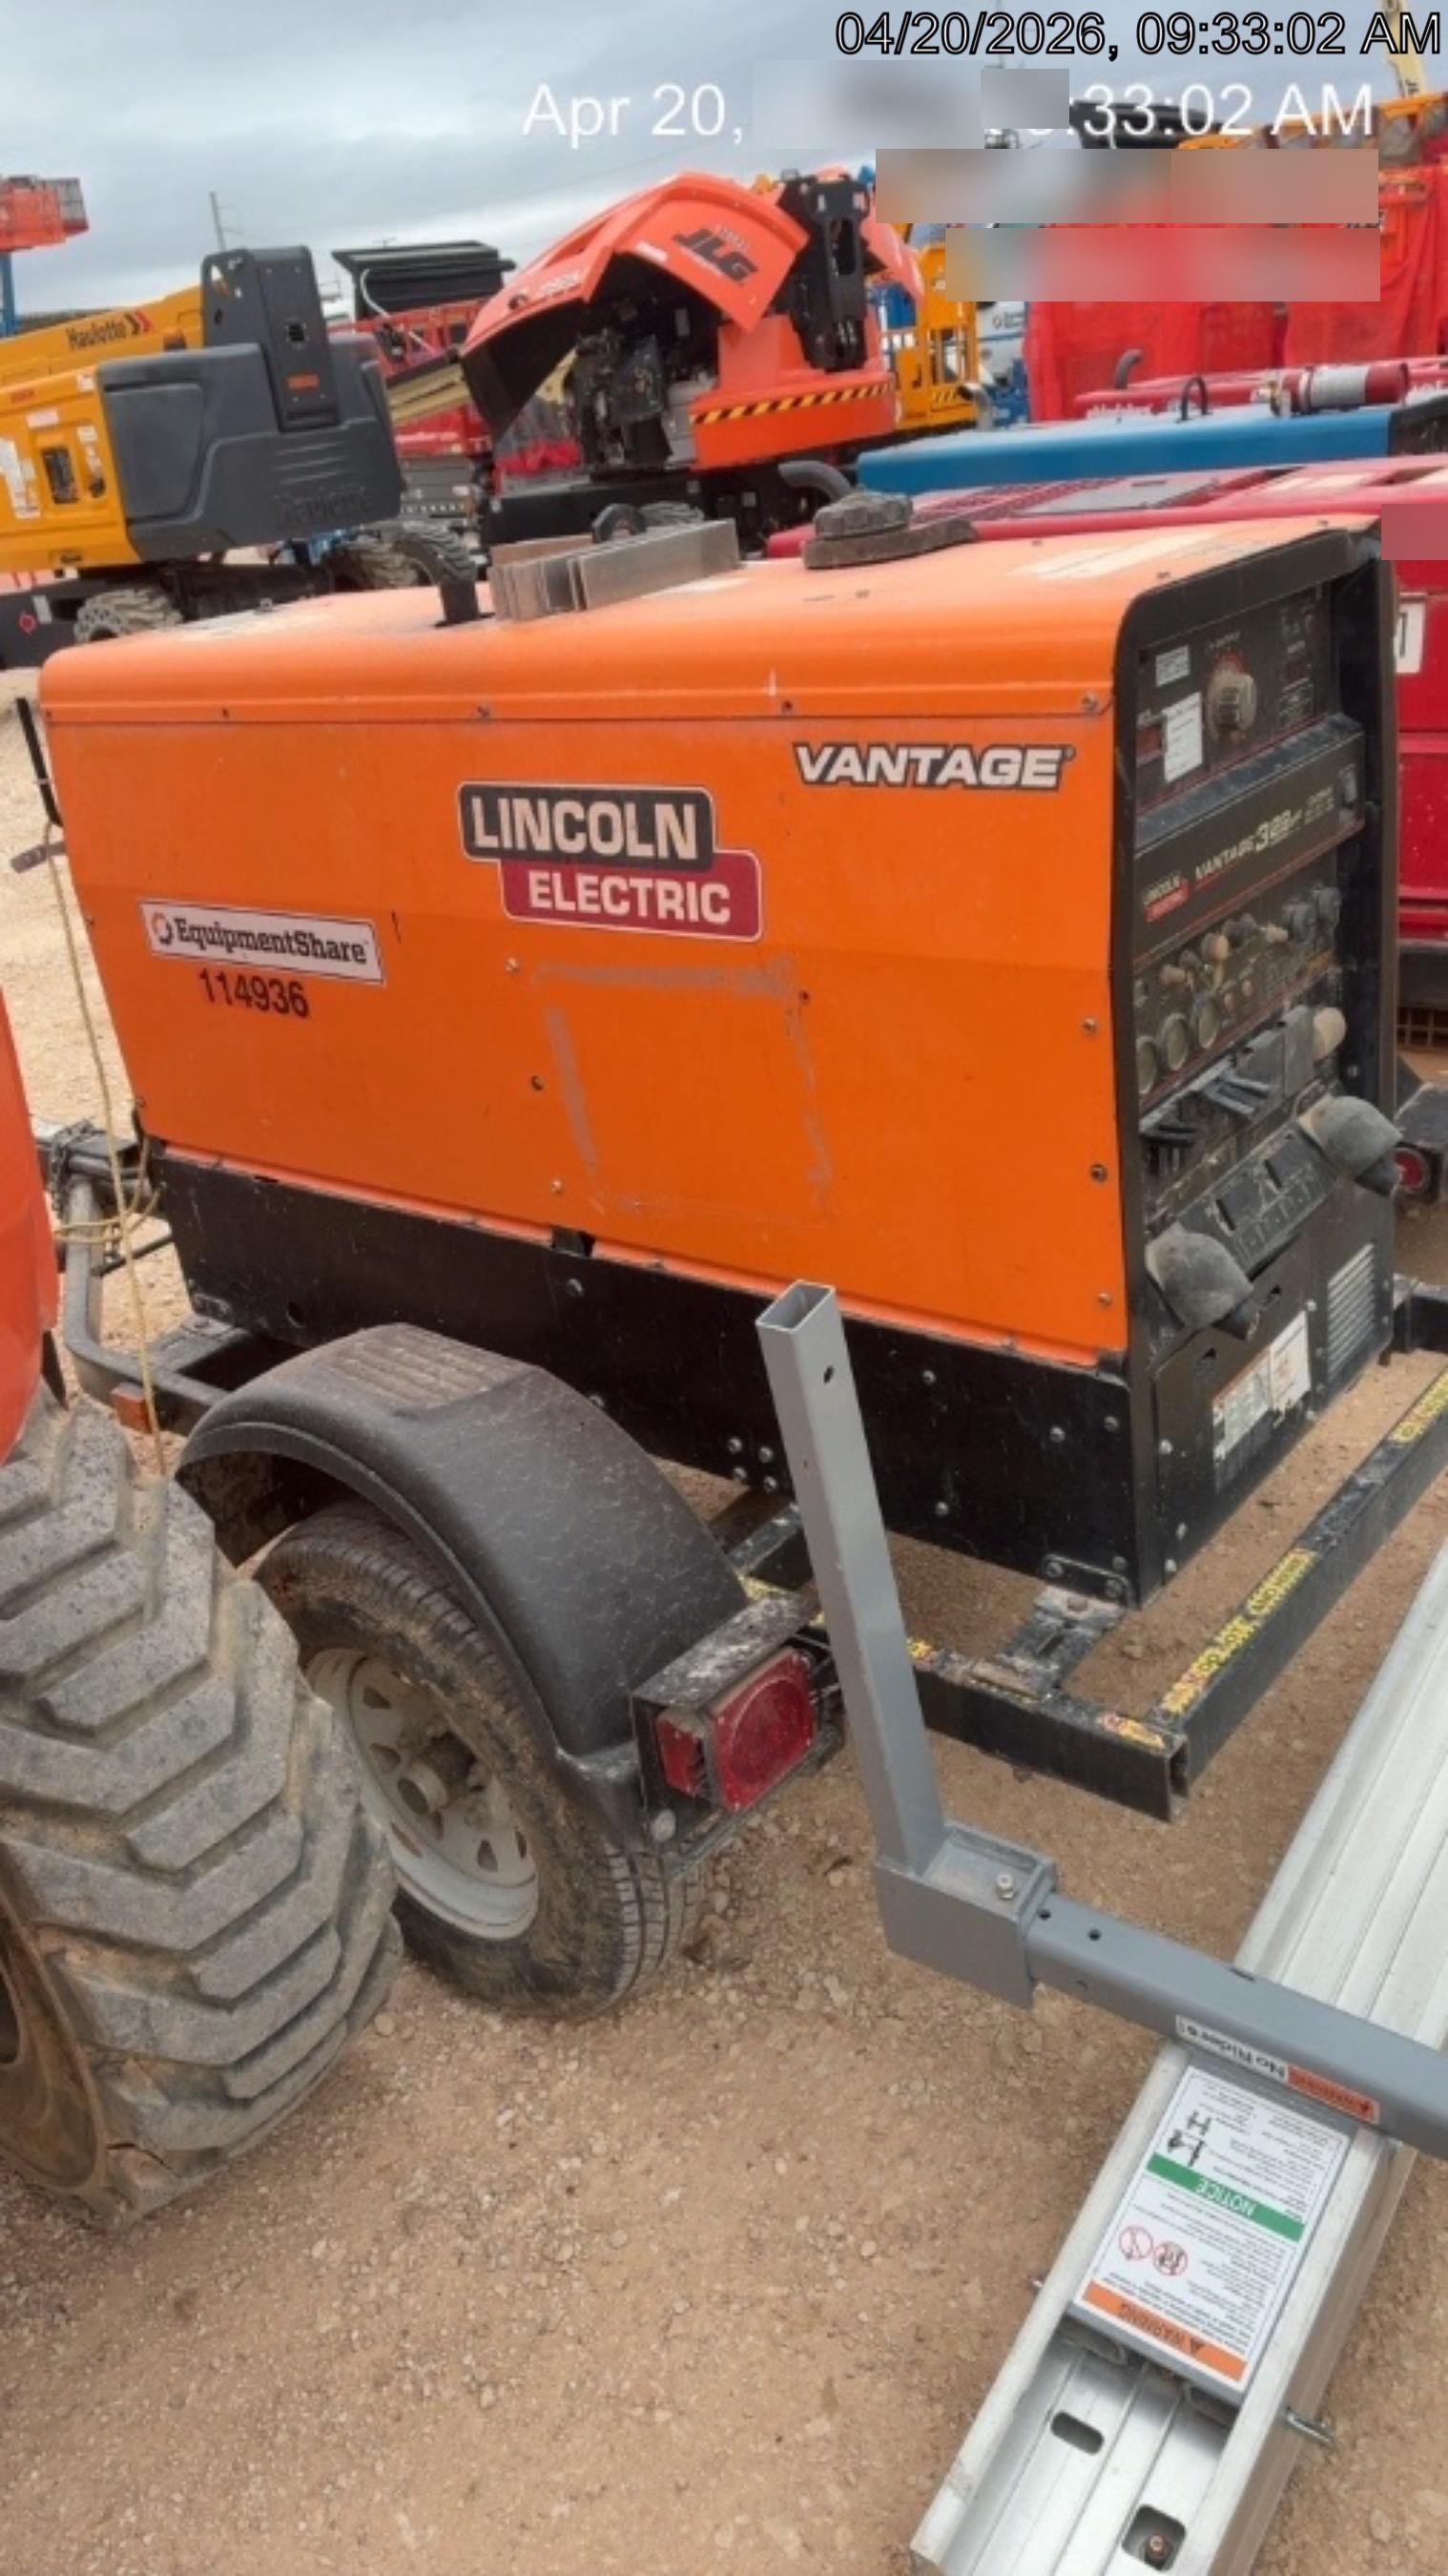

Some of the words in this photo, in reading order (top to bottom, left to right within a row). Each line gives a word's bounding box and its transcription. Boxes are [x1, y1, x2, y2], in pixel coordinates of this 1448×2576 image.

[672, 227, 759, 283] JLG
[793, 743, 1064, 791] VANTAGE
[470, 797, 698, 859] LINCOLN
[527, 869, 732, 924] ELECTRIC
[174, 917, 368, 966] EquipmentShare
[198, 966, 310, 1019] 114936
[1195, 2177, 1255, 2217] NOTICE
